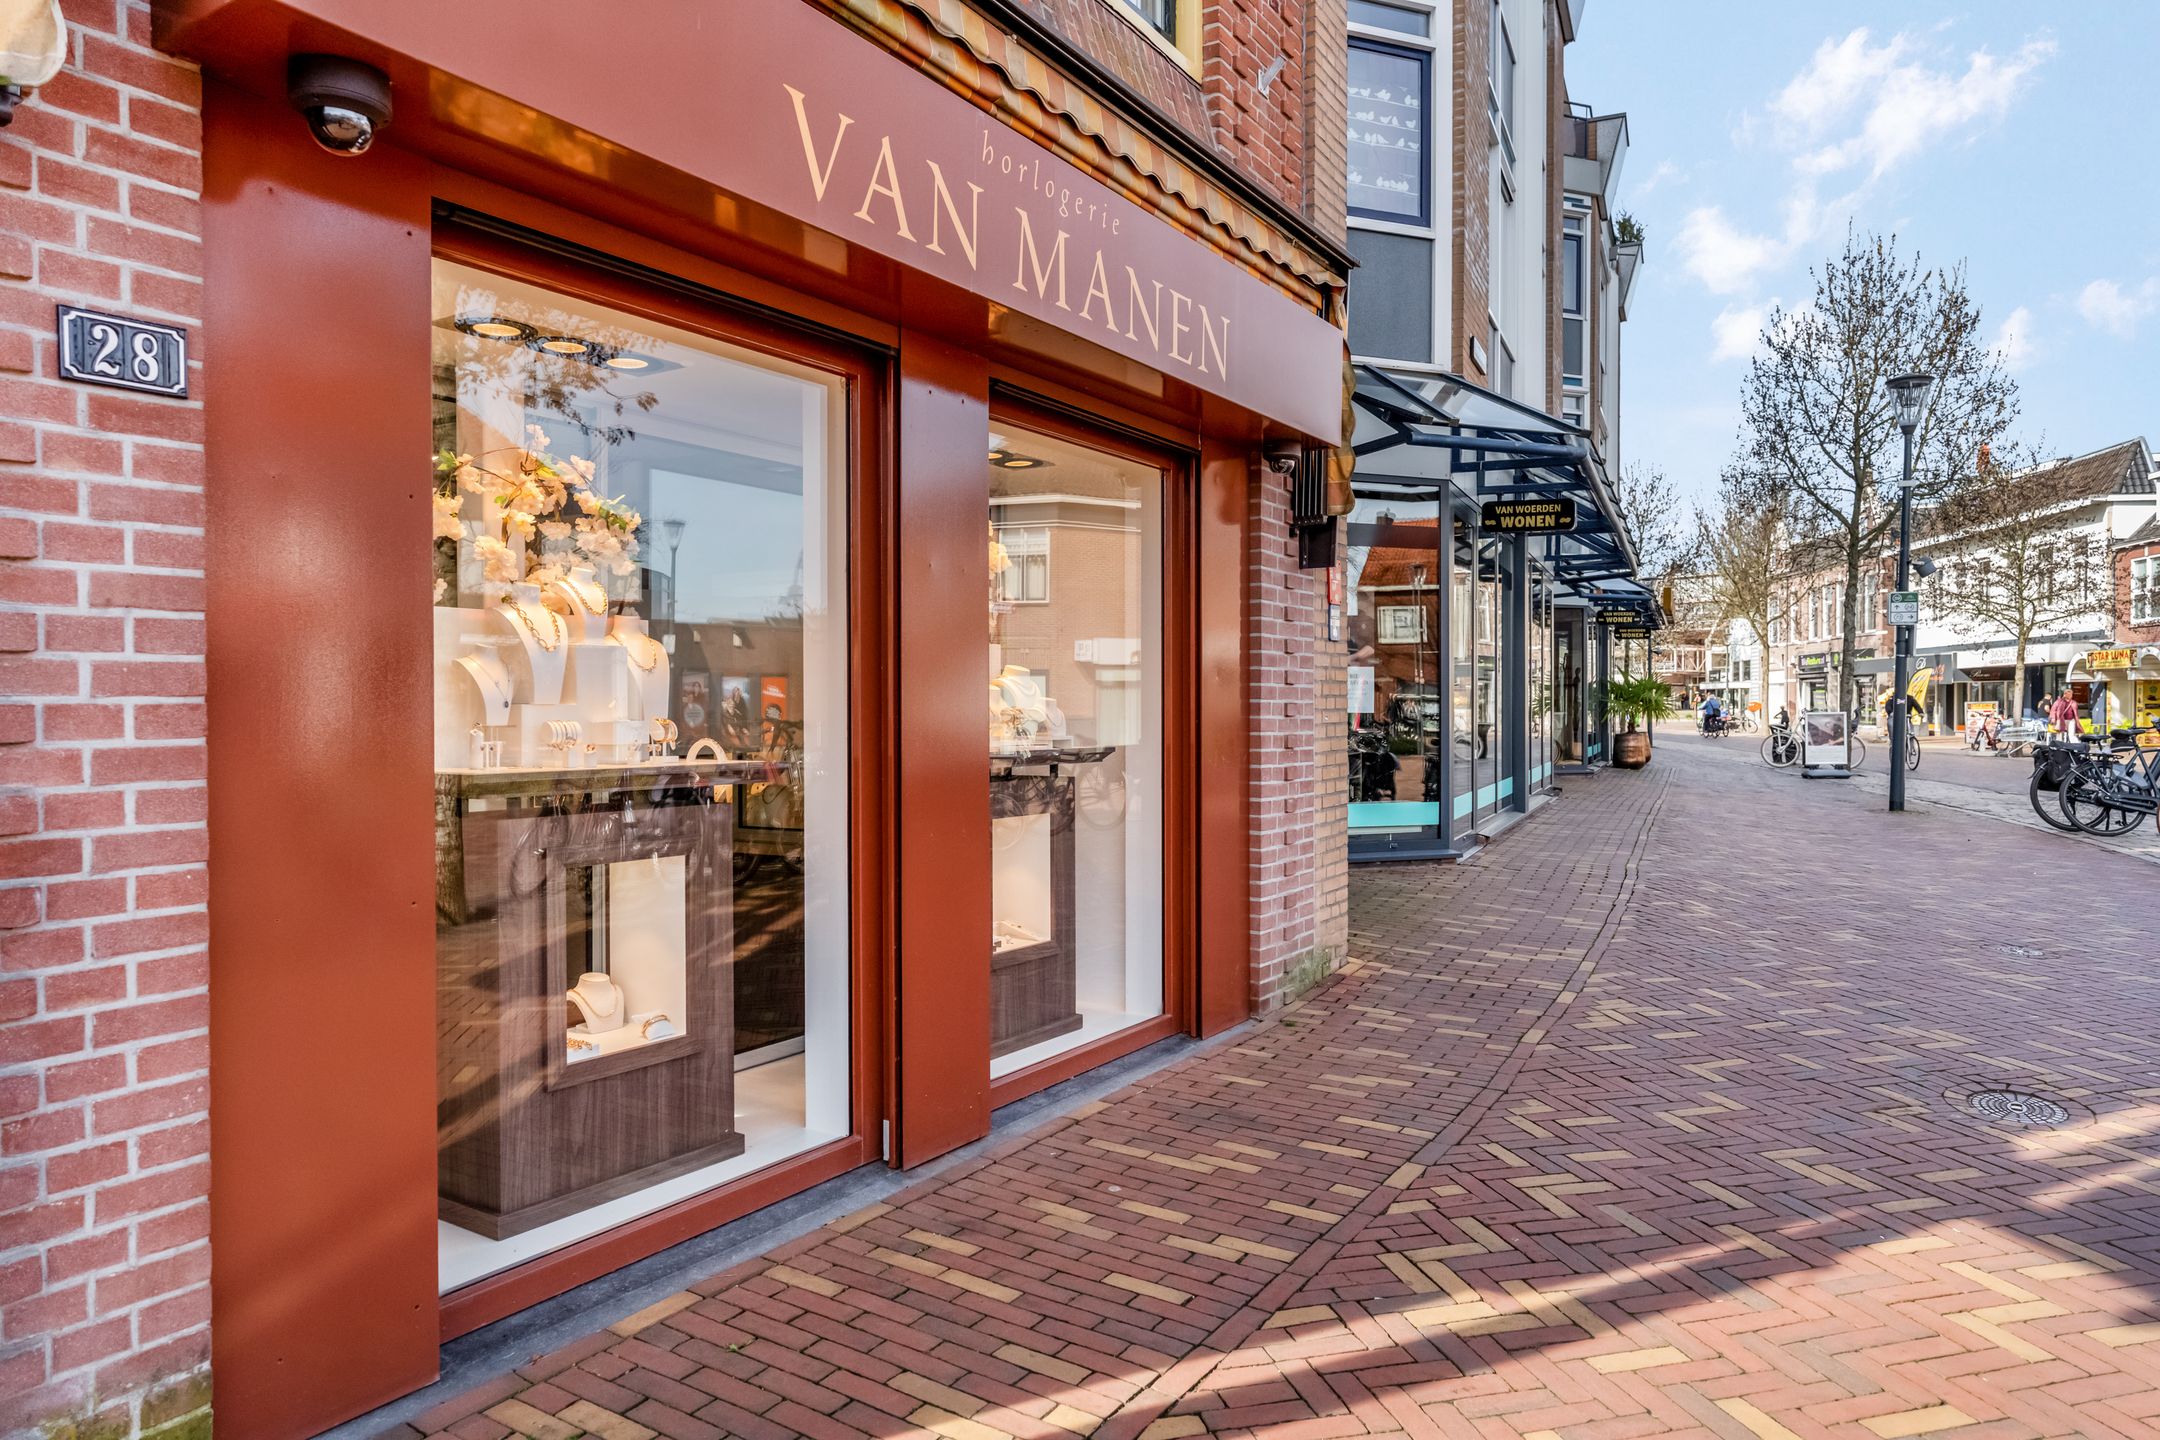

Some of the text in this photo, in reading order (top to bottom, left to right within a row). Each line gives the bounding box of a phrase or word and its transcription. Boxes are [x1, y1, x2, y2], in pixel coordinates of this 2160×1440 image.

[981, 129, 1121, 236] horlogerie
[782, 83, 1231, 383] VAN MANEN
[91, 323, 159, 382] 28
[1495, 503, 1562, 514] VAN WOERDEN
[1500, 514, 1556, 528] WONEN
[2093, 649, 2129, 661] STAR LUNA
